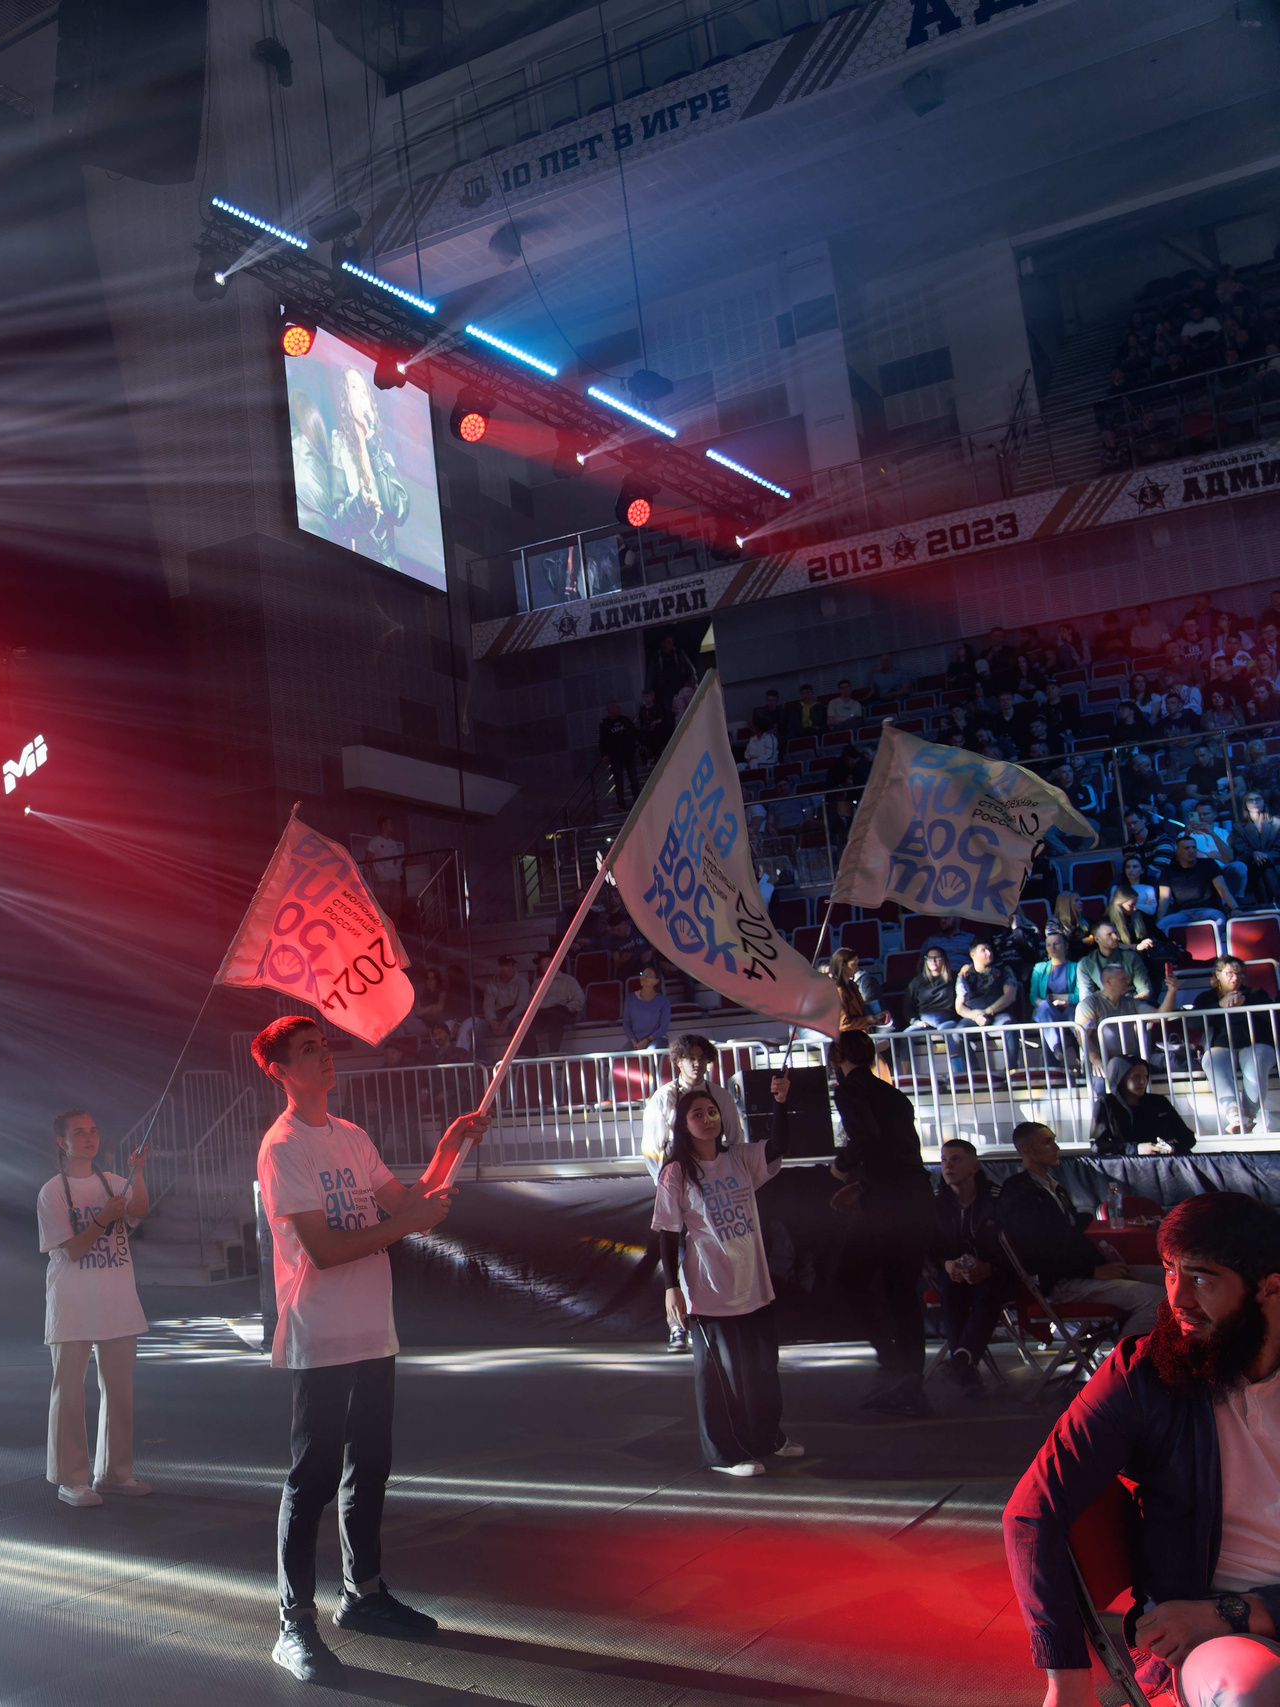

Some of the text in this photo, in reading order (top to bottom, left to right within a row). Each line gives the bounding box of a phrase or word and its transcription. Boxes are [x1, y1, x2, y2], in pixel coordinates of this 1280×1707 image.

[538, 133, 603, 179] ЛЕТ
[612, 122, 634, 151] В
[640, 83, 732, 140] ИГРЕ
[807, 512, 1019, 583] 2013 2023
[589, 588, 708, 632] АДМИРАЛ
[322, 906, 362, 939] России
[332, 898, 376, 935] столица
[736, 891, 778, 983] 2024
[321, 936, 397, 1011] 2024
